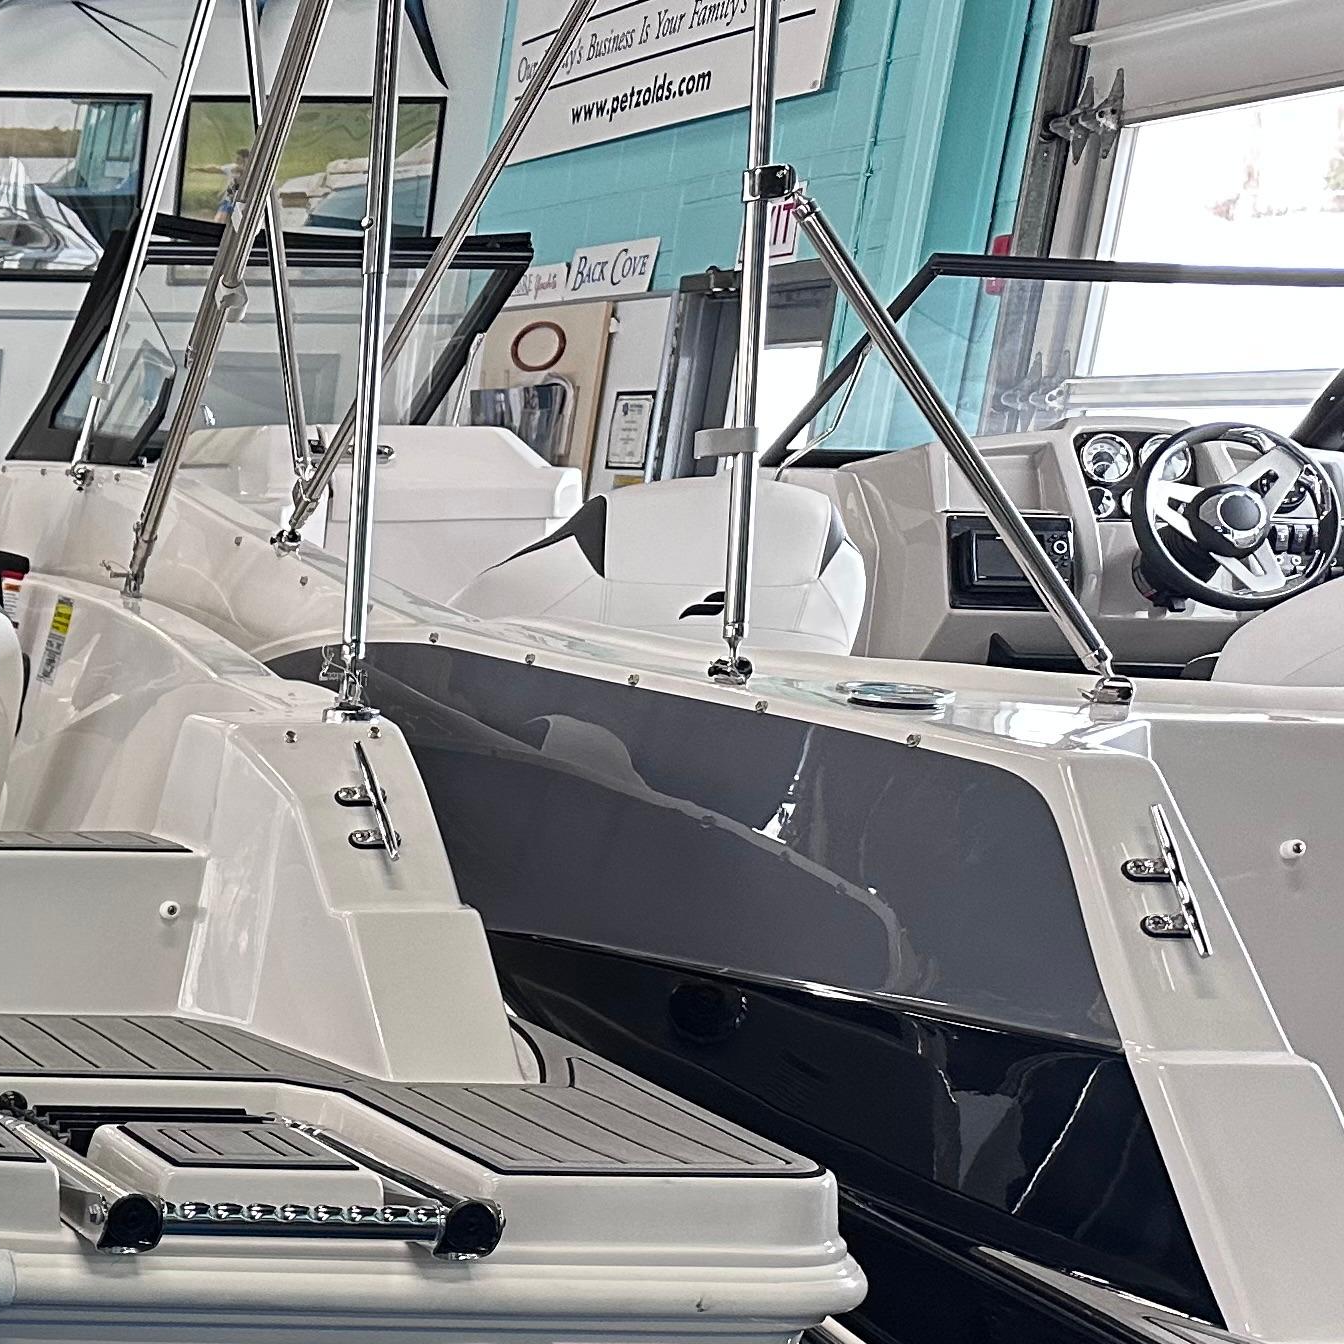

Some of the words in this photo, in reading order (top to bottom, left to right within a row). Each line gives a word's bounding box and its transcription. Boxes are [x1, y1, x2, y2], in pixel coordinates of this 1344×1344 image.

[586, 29, 636, 61] Business
[638, 15, 651, 45] Is
[655, 9, 686, 40] Your
[688, 0, 747, 29] Familys
[571, 70, 712, 125] www.petzolds.com
[770, 202, 794, 246] IT
[571, 256, 608, 291] BACK
[610, 248, 650, 286] COVE
